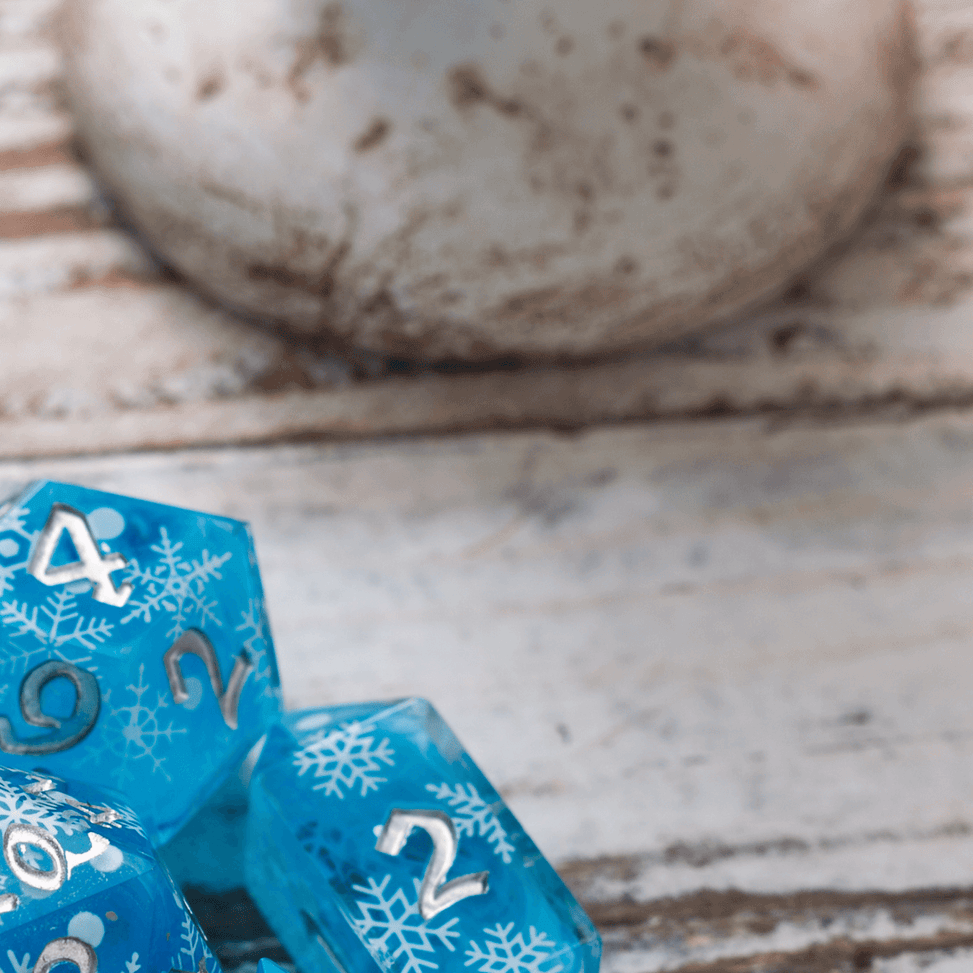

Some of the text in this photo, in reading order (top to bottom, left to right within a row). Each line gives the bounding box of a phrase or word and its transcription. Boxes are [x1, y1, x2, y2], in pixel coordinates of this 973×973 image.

[28, 502, 134, 607] 4
[163, 627, 251, 730] 2
[375, 808, 489, 919] 2
